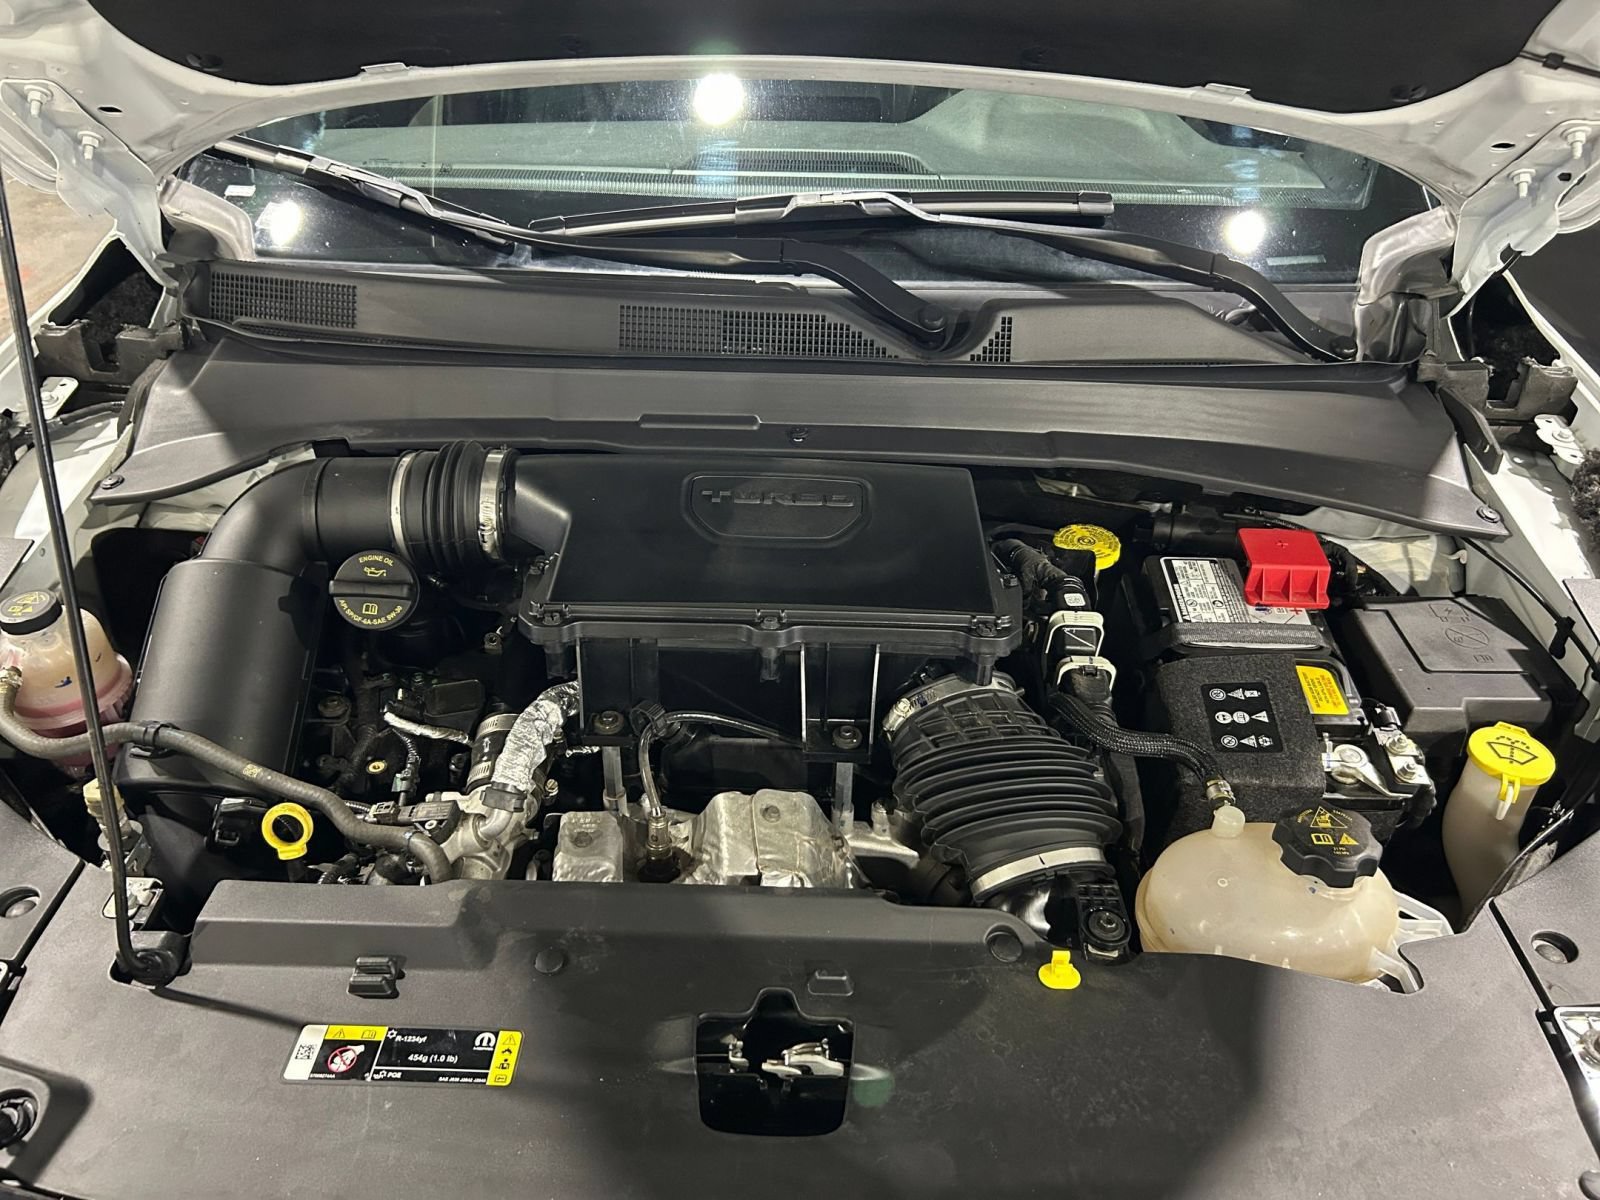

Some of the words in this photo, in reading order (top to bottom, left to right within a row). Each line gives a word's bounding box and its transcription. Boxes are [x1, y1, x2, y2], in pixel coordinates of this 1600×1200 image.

[358, 555, 383, 563] ENGINE
[383, 557, 395, 567] OIL
[395, 1035, 428, 1044] R-1234yf
[407, 1053, 429, 1063] 454g
[429, 1054, 446, 1064] (1.0
[446, 1054, 459, 1064] lb)
